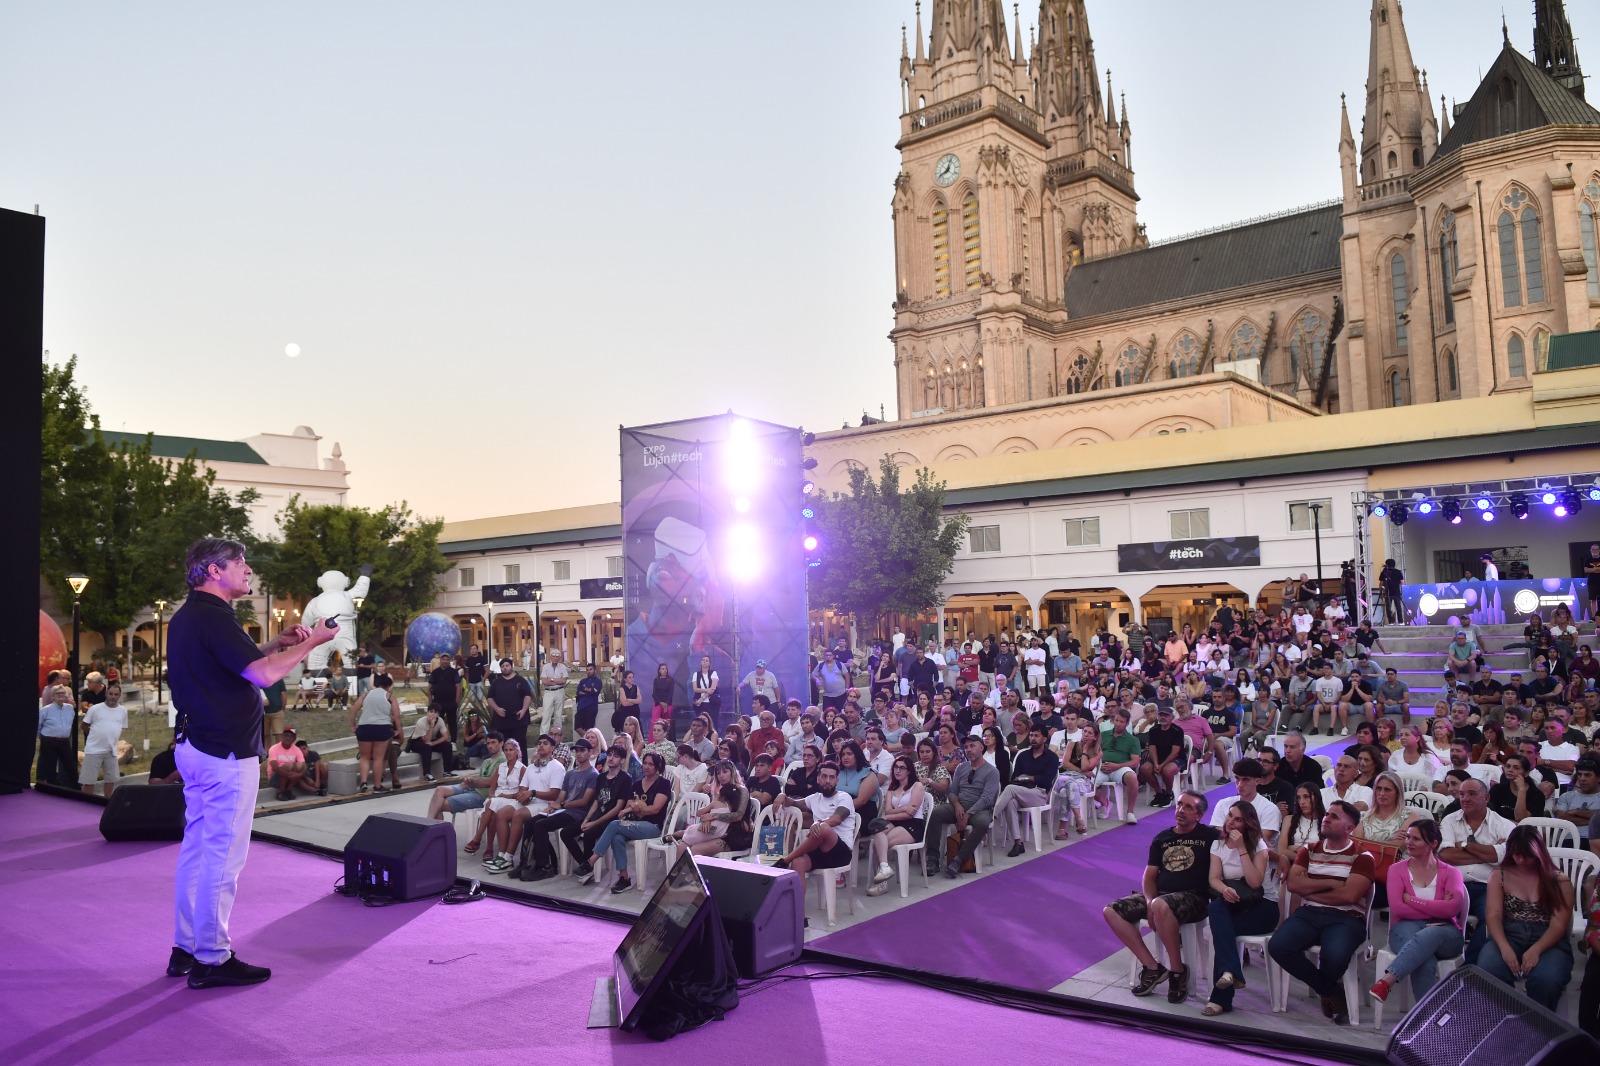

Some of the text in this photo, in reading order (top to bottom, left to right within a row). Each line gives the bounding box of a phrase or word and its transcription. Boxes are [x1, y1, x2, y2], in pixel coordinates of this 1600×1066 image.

[643, 444, 666, 455] EXPO
[643, 450, 703, 469] Luján#tech
[1169, 548, 1204, 560] #tech
